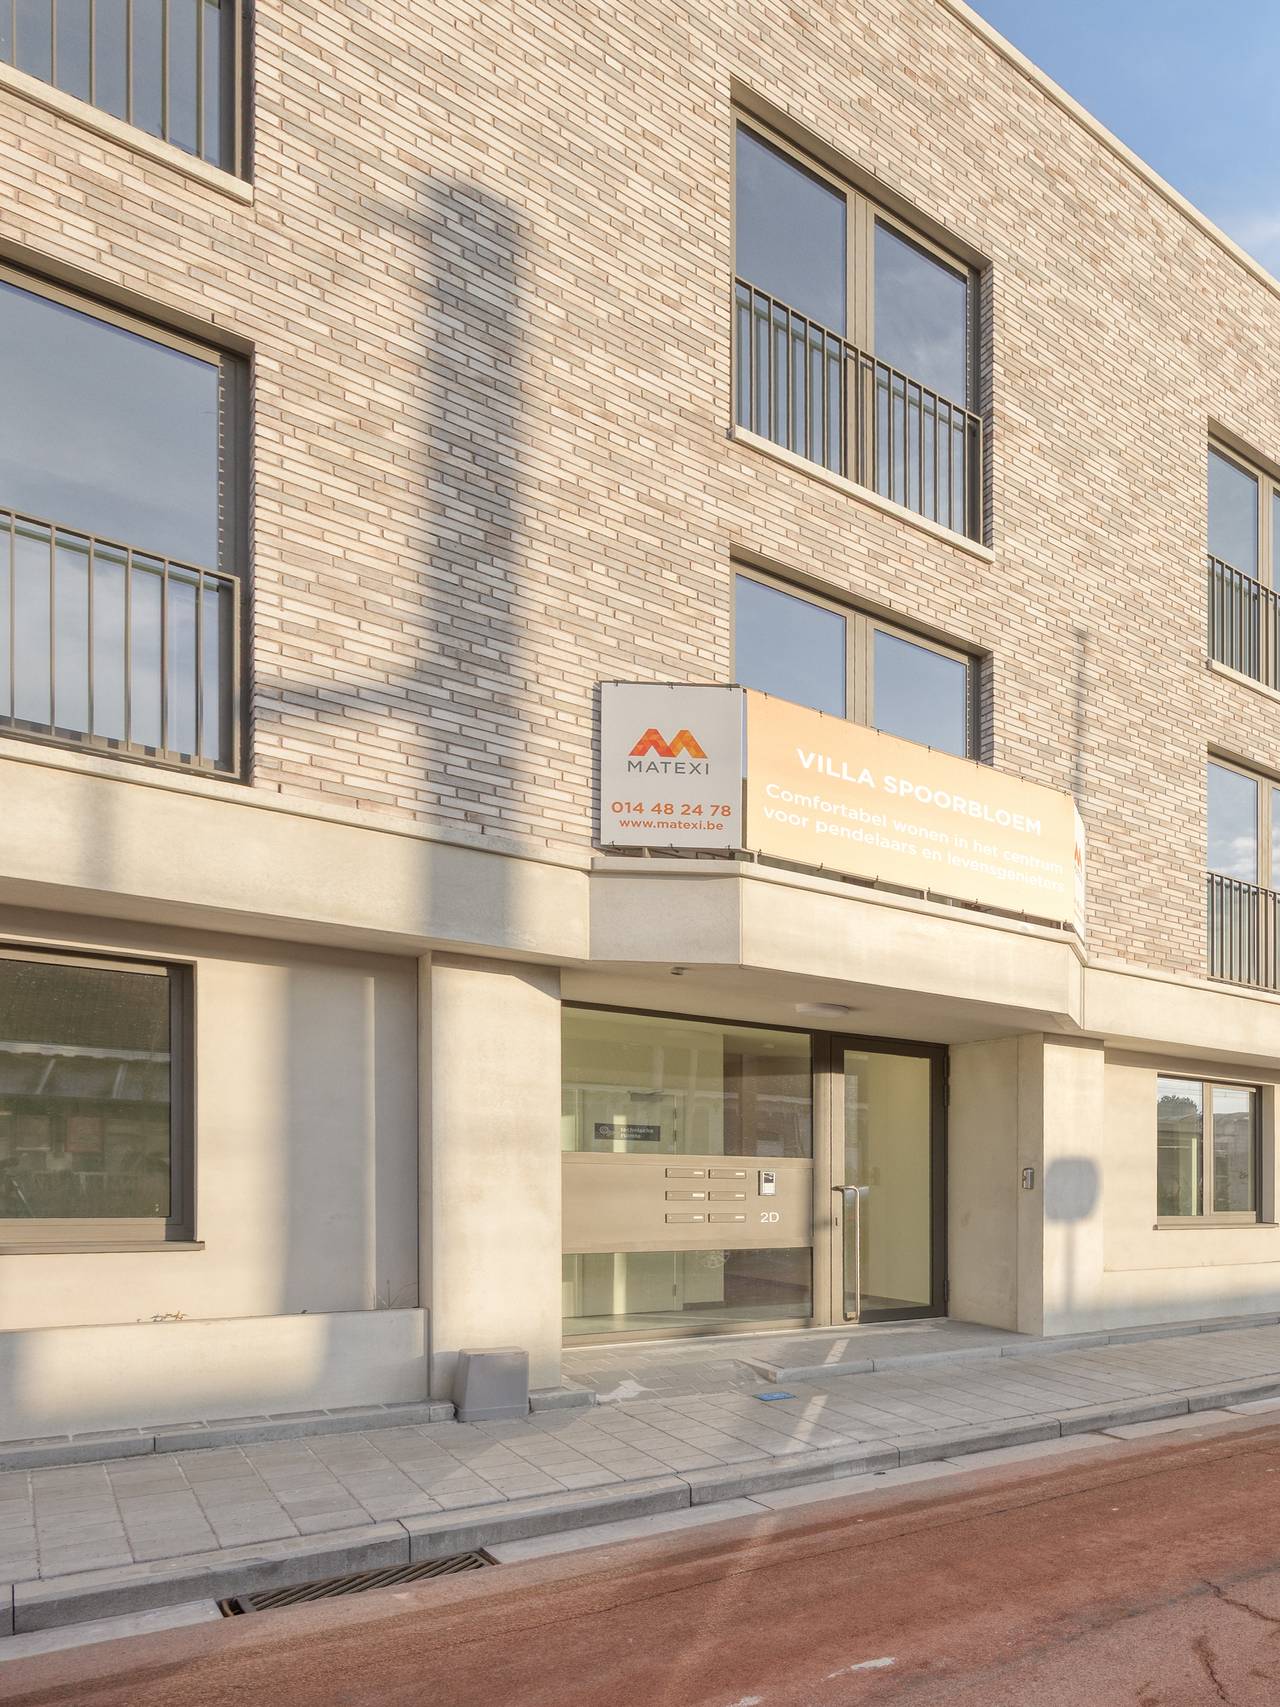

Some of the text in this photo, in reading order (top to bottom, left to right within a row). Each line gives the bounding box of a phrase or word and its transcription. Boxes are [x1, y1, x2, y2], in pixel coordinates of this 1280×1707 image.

[627, 760, 709, 775] MATEXI
[796, 748, 1042, 837] VILLA SPOORBLOEM
[611, 801, 732, 818] 014 48 24 78
[619, 819, 724, 831] www.matexi.be
[765, 783, 887, 828] Comfortabel
[893, 819, 949, 844] wonen
[953, 833, 968, 850] in
[973, 840, 999, 859] het
[1003, 850, 1064, 876] centrum
[763, 806, 809, 829] voor
[815, 820, 918, 857] pendelaars
[922, 846, 942, 863] en
[760, 1211, 780, 1223] 2D
